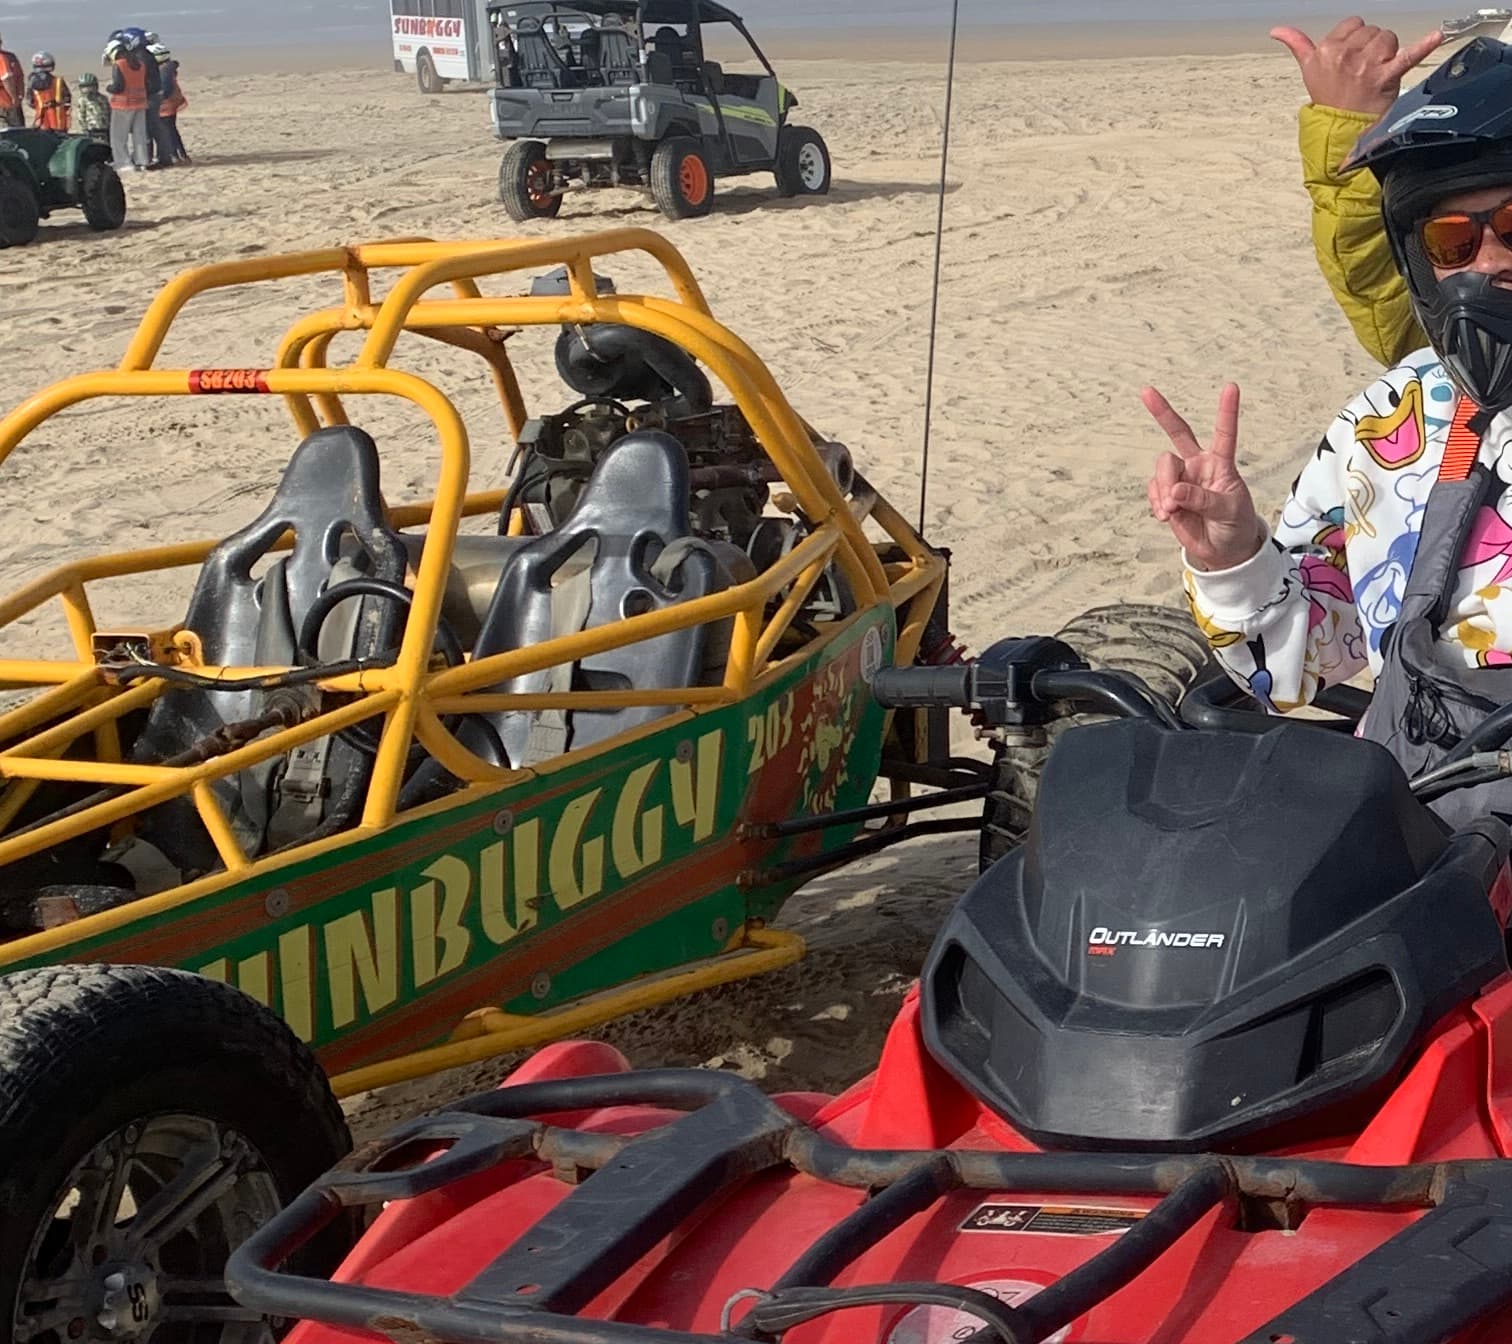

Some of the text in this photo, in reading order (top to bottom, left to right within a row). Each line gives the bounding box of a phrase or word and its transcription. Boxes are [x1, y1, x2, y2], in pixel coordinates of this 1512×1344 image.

[394, 17, 462, 37] SUNBGGY
[200, 370, 257, 389] SB203
[748, 691, 794, 775] 203
[200, 728, 724, 1044] UNBUGGY
[1088, 927, 1225, 948] OUTLANDER
